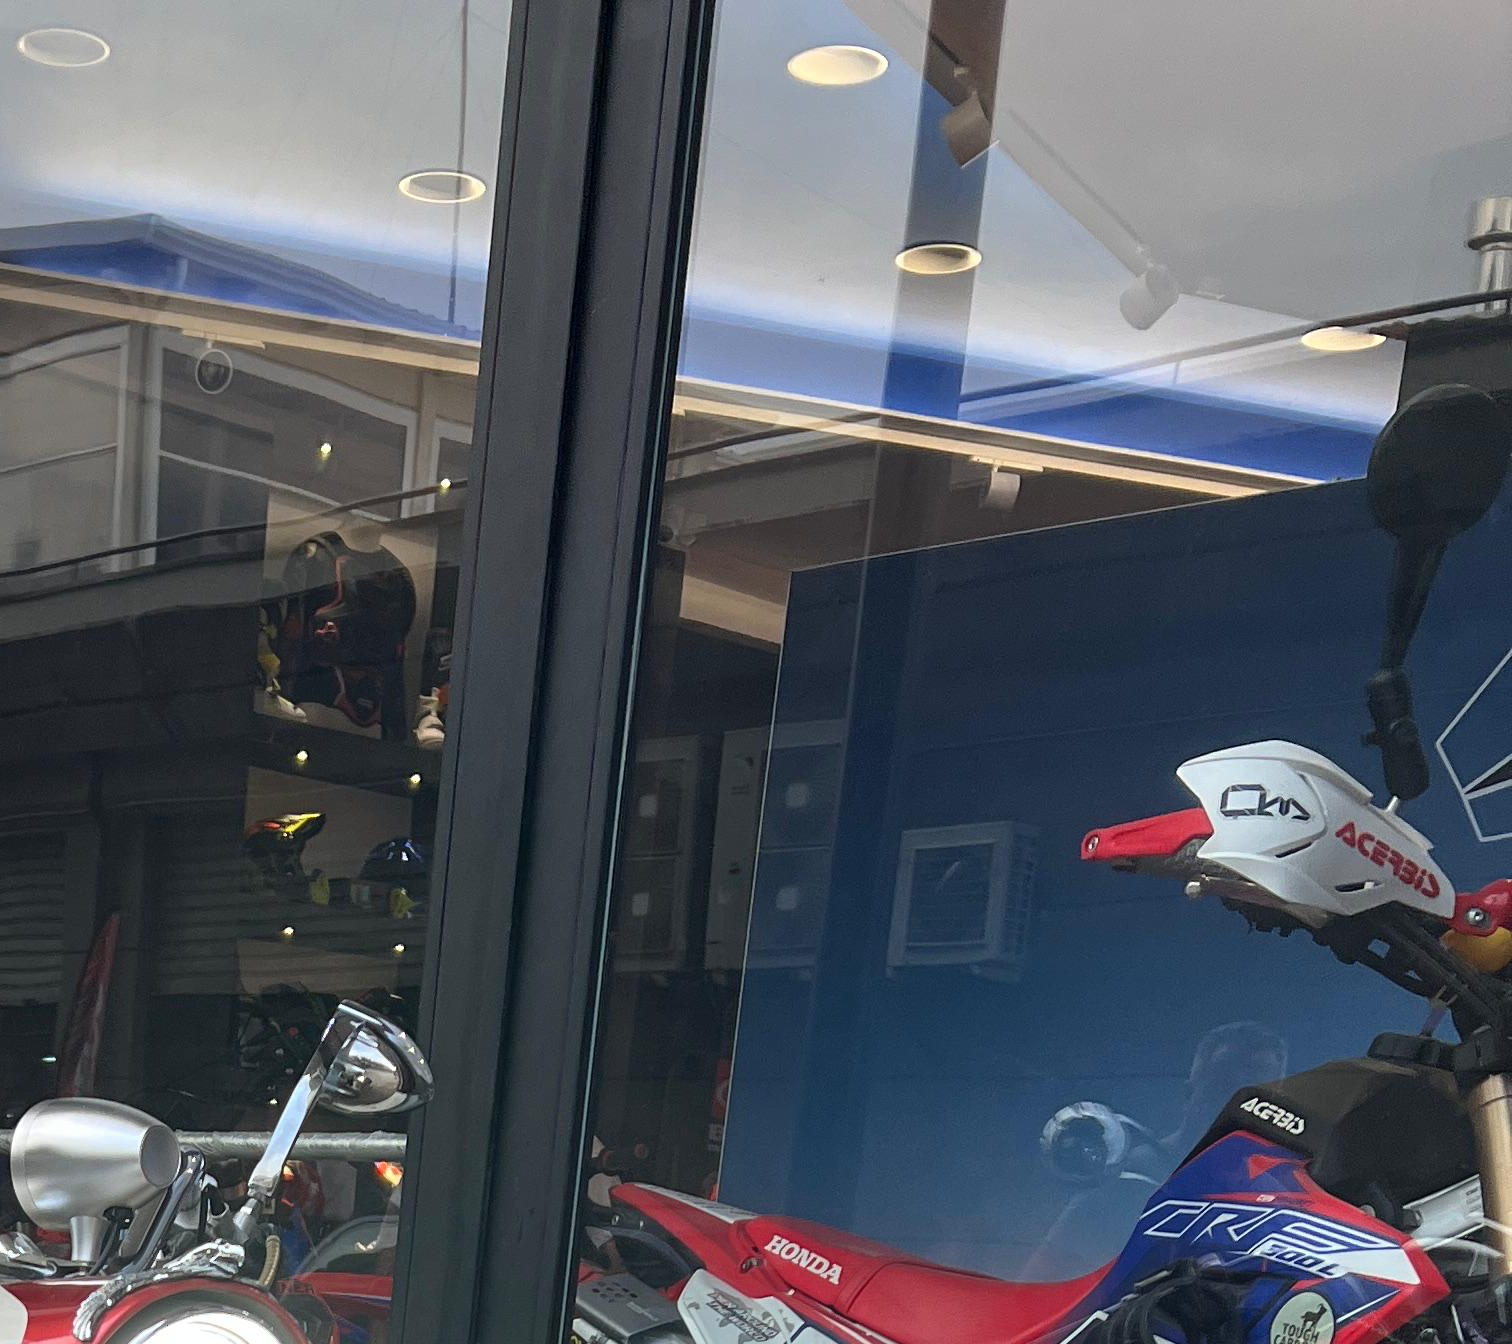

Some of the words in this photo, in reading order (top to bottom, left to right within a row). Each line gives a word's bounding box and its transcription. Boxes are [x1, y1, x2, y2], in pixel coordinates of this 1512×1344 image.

[1334, 821, 1441, 899] ACERBIS
[1240, 1097, 1305, 1135] ACERBIS
[764, 1235, 843, 1285] HONDA
[1282, 1322, 1320, 1342] TOUGH
